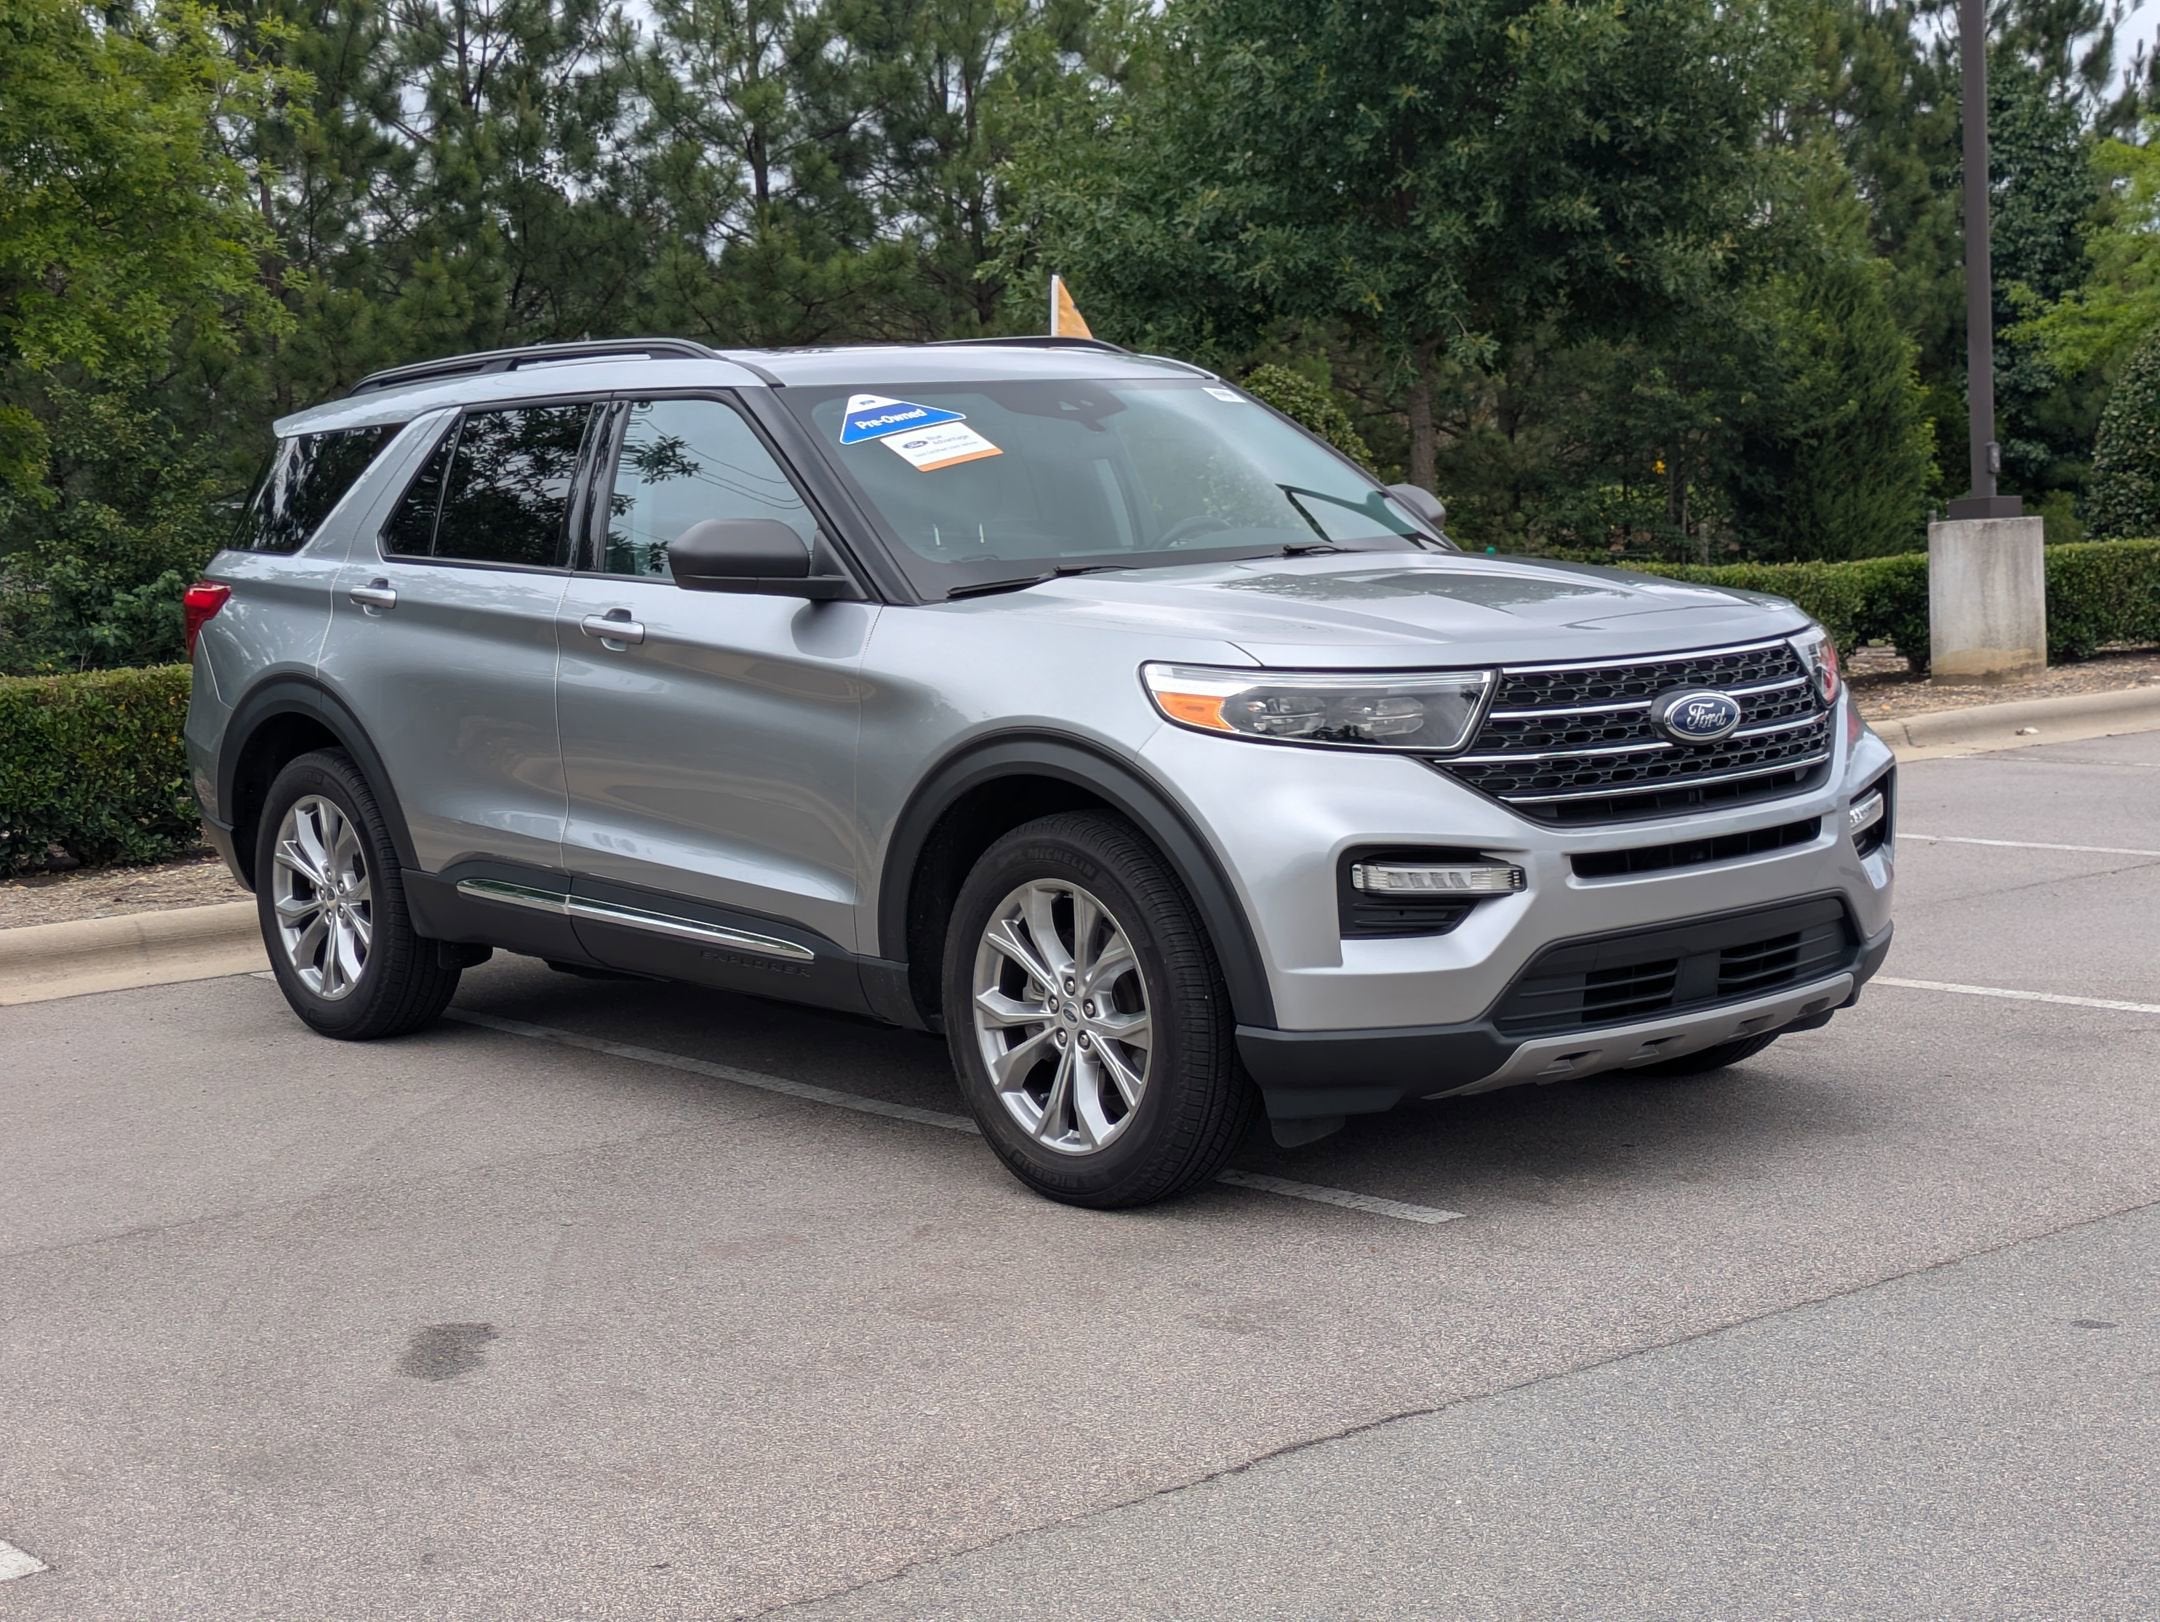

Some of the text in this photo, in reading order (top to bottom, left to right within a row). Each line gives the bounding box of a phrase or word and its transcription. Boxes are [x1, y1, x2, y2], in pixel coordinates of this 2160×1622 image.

[854, 408, 928, 430] Pre-Owned
[1686, 702, 1727, 730] Ford
[1025, 847, 1096, 879] MICHELIN
[700, 950, 812, 978] EXPLORER
